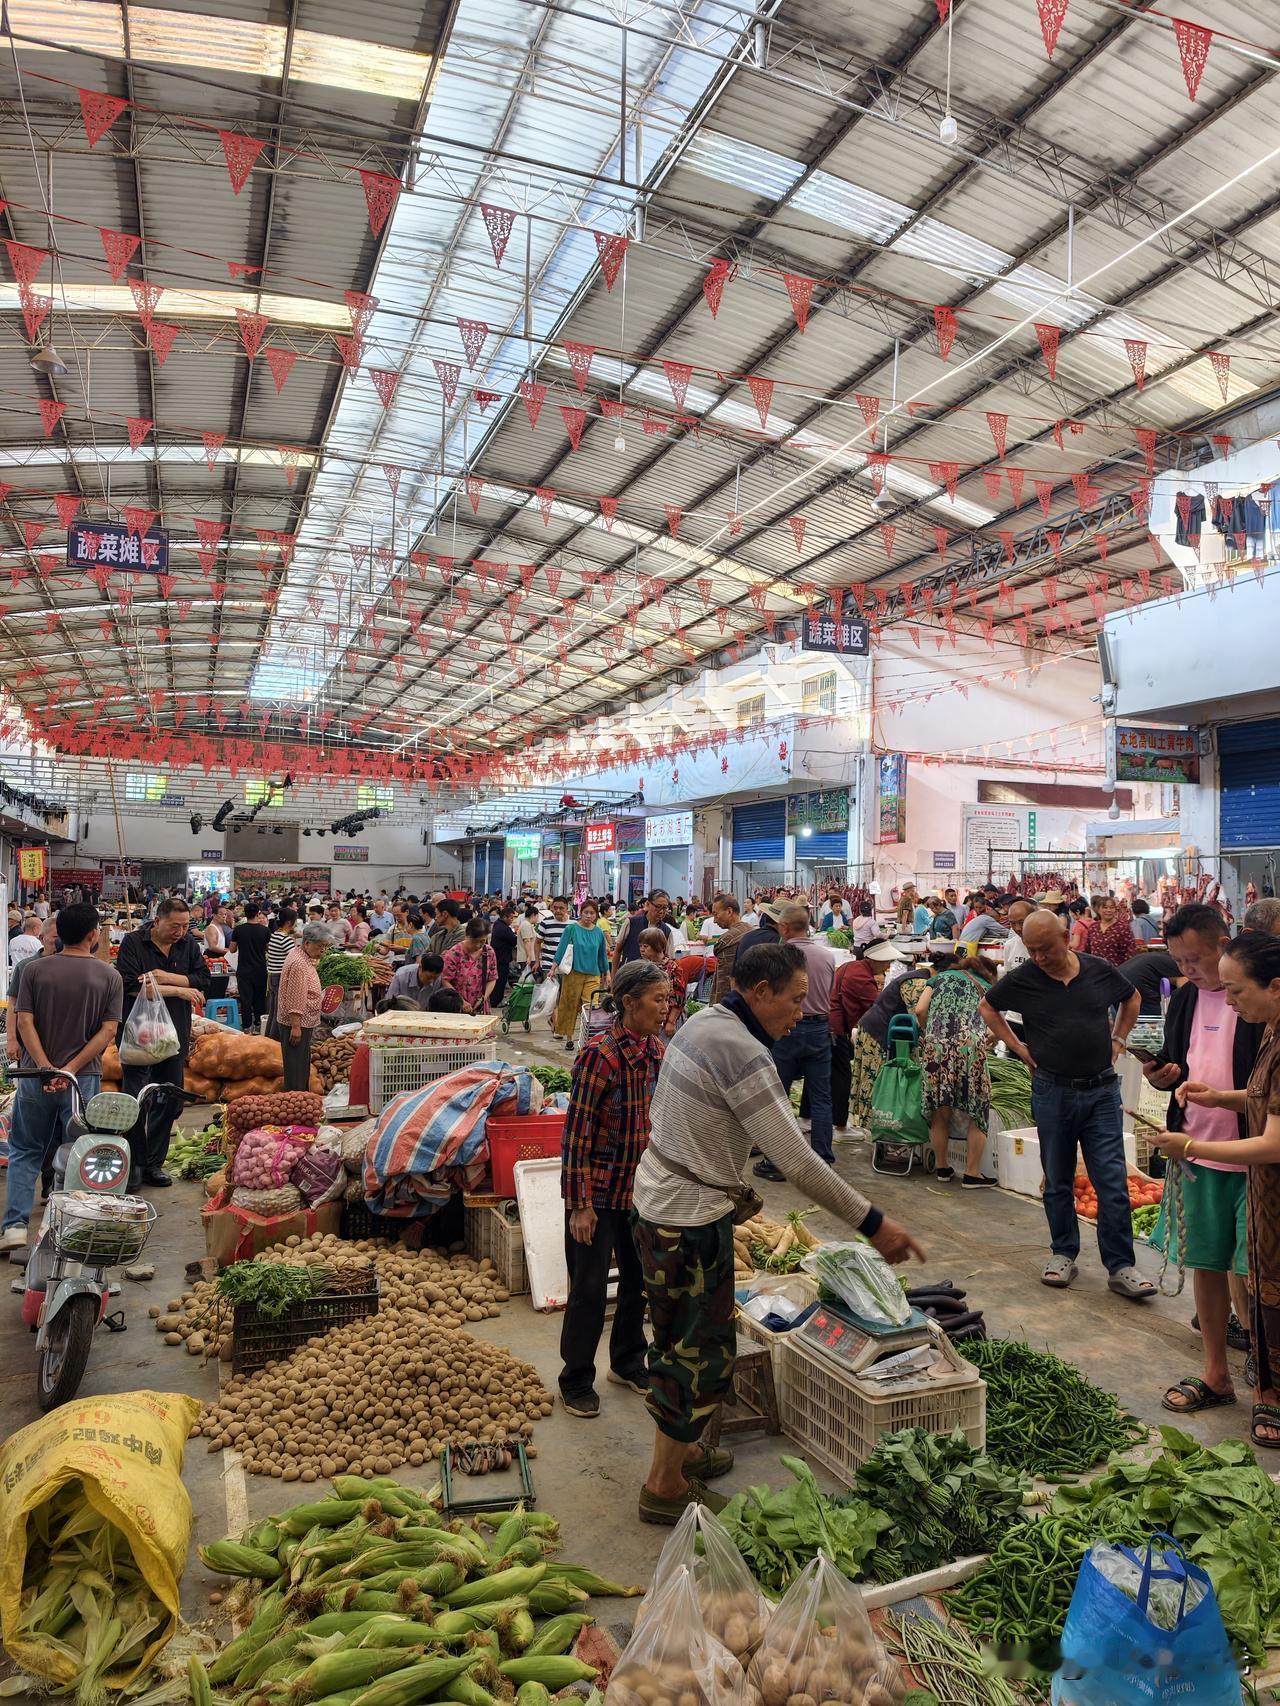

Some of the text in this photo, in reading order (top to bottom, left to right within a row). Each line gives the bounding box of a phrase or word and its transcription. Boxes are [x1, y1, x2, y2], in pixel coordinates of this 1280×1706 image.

[77, 531, 160, 565] 蔬菜摊区
[1119, 731, 1194, 752] 本地高山土黄牛肉
